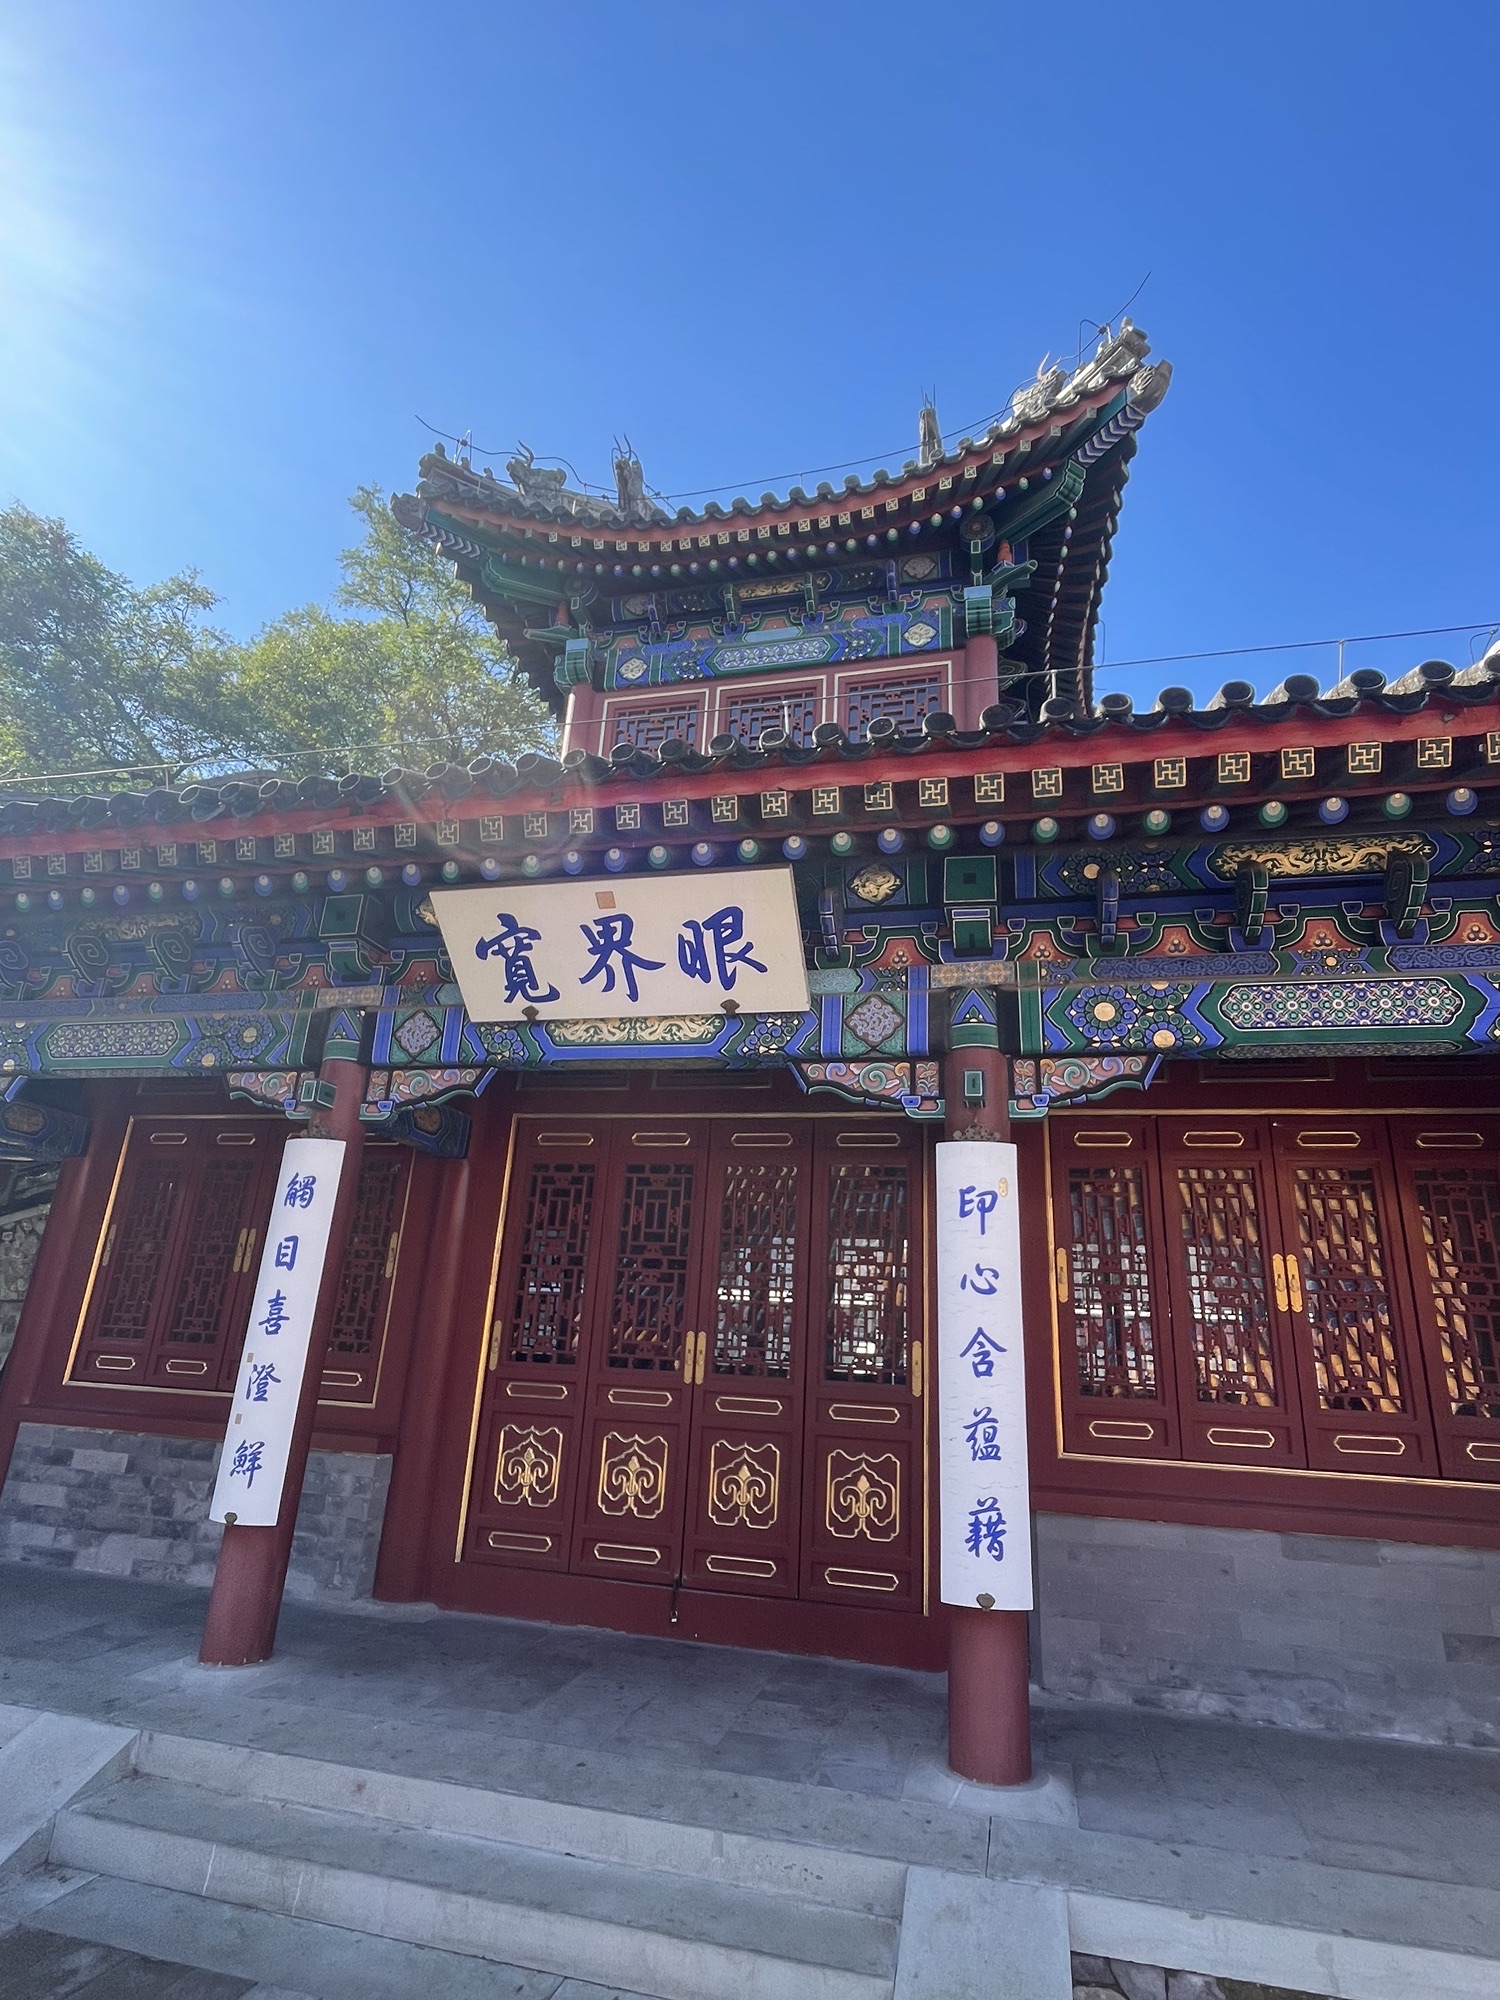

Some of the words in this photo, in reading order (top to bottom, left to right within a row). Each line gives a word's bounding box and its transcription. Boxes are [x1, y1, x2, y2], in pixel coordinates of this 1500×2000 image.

[230, 1172, 317, 1489] 觸目喜澄鮮
